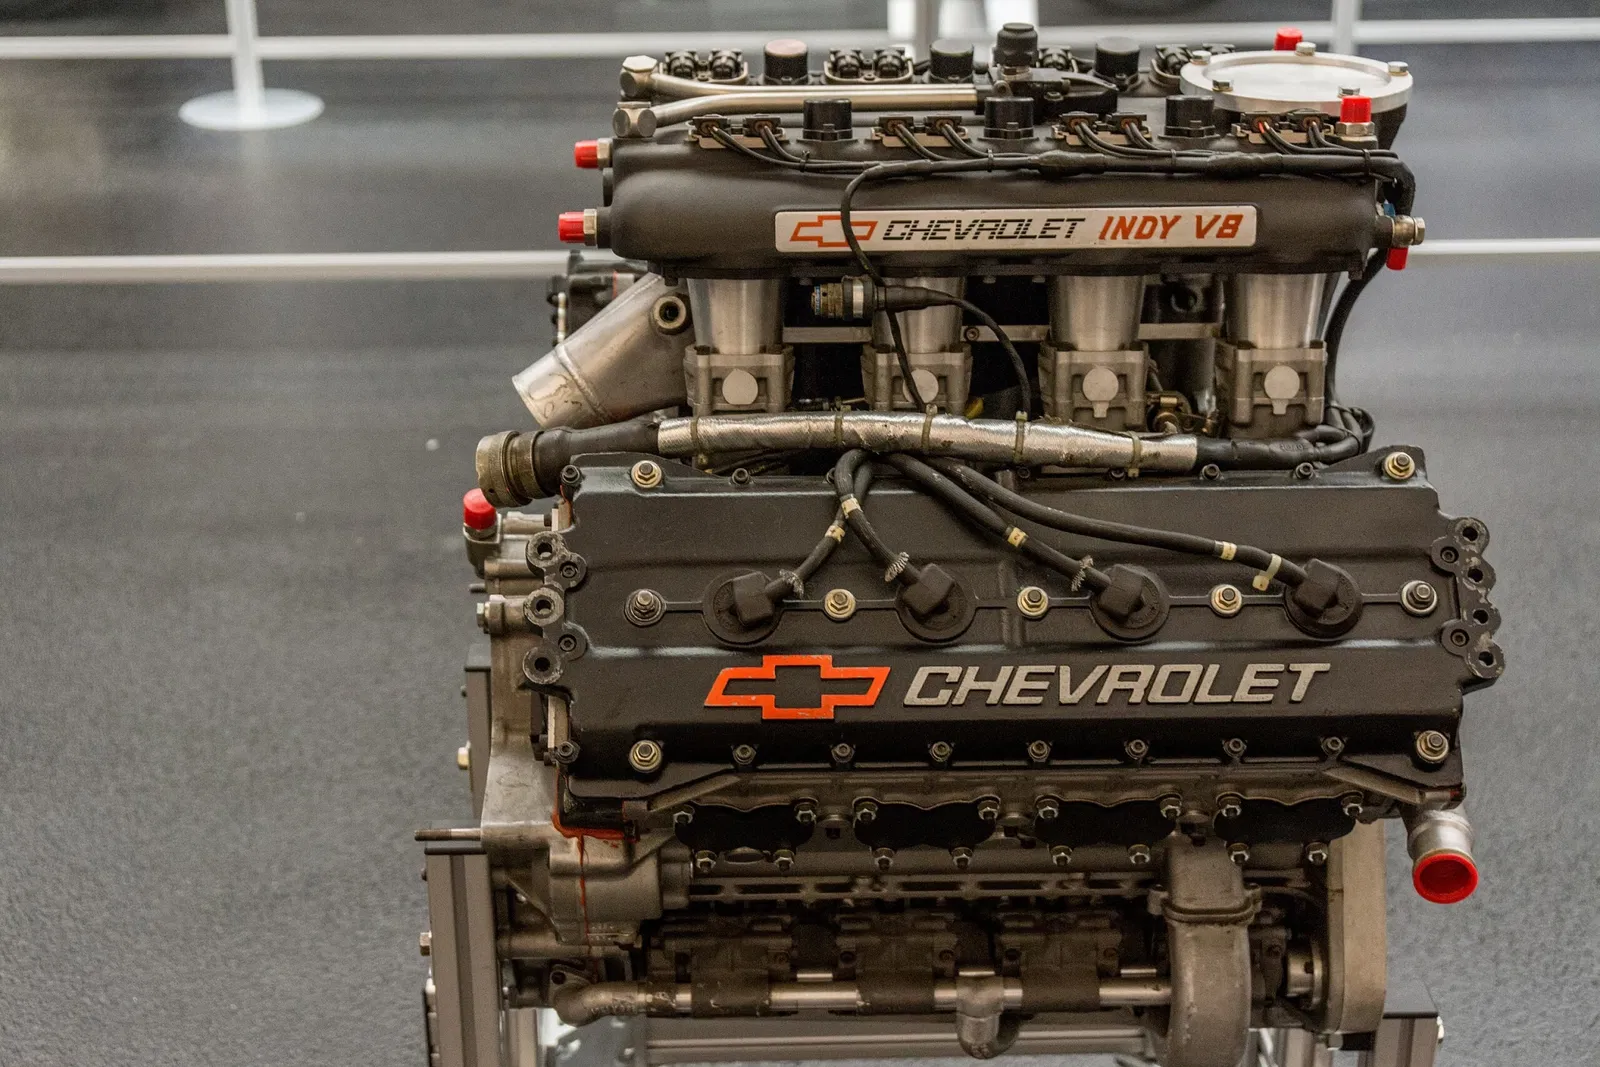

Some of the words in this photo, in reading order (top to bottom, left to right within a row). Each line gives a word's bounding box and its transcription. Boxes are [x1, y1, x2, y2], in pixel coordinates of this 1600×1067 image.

[882, 218, 1087, 242] CHEVROLET
[1098, 214, 1182, 242] INDY
[1194, 212, 1245, 241] V8
[903, 662, 1331, 706] CHEVROLET
